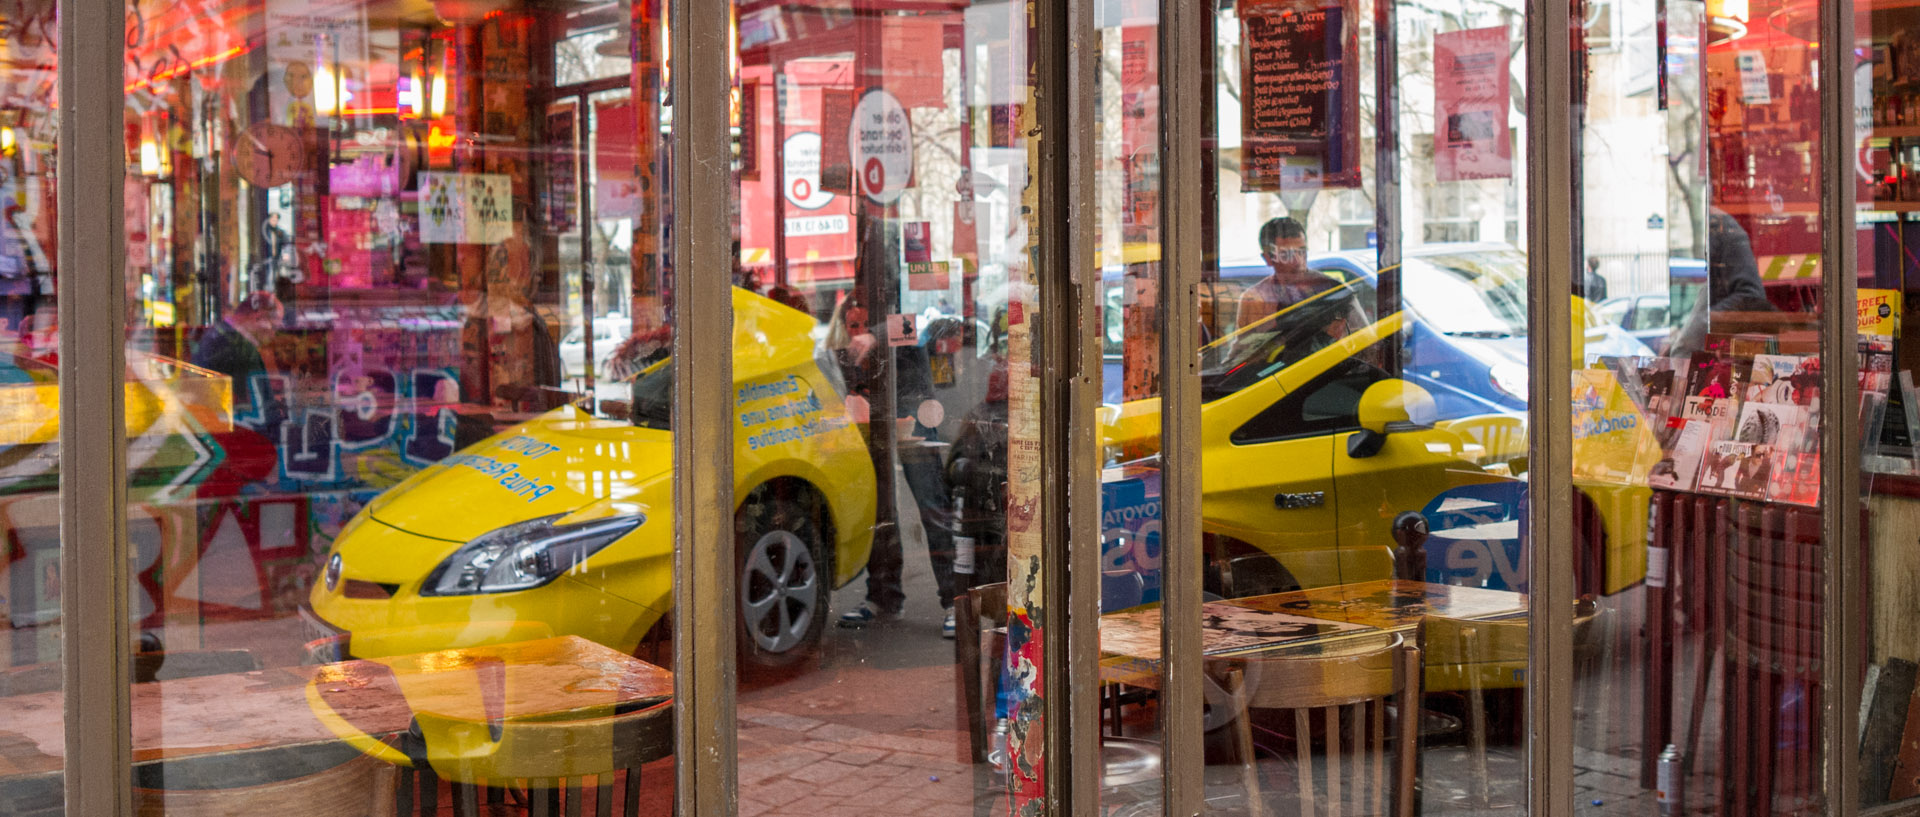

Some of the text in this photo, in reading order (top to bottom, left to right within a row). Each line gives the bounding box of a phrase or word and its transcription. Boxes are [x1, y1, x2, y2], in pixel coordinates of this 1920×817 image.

[1301, 11, 1326, 22] Verre
[910, 263, 948, 273] UN LIEU
[1857, 294, 1888, 309] TREET
[1857, 307, 1868, 318] RT
[1857, 314, 1882, 327] OURS
[1690, 401, 1727, 417] TMODE
